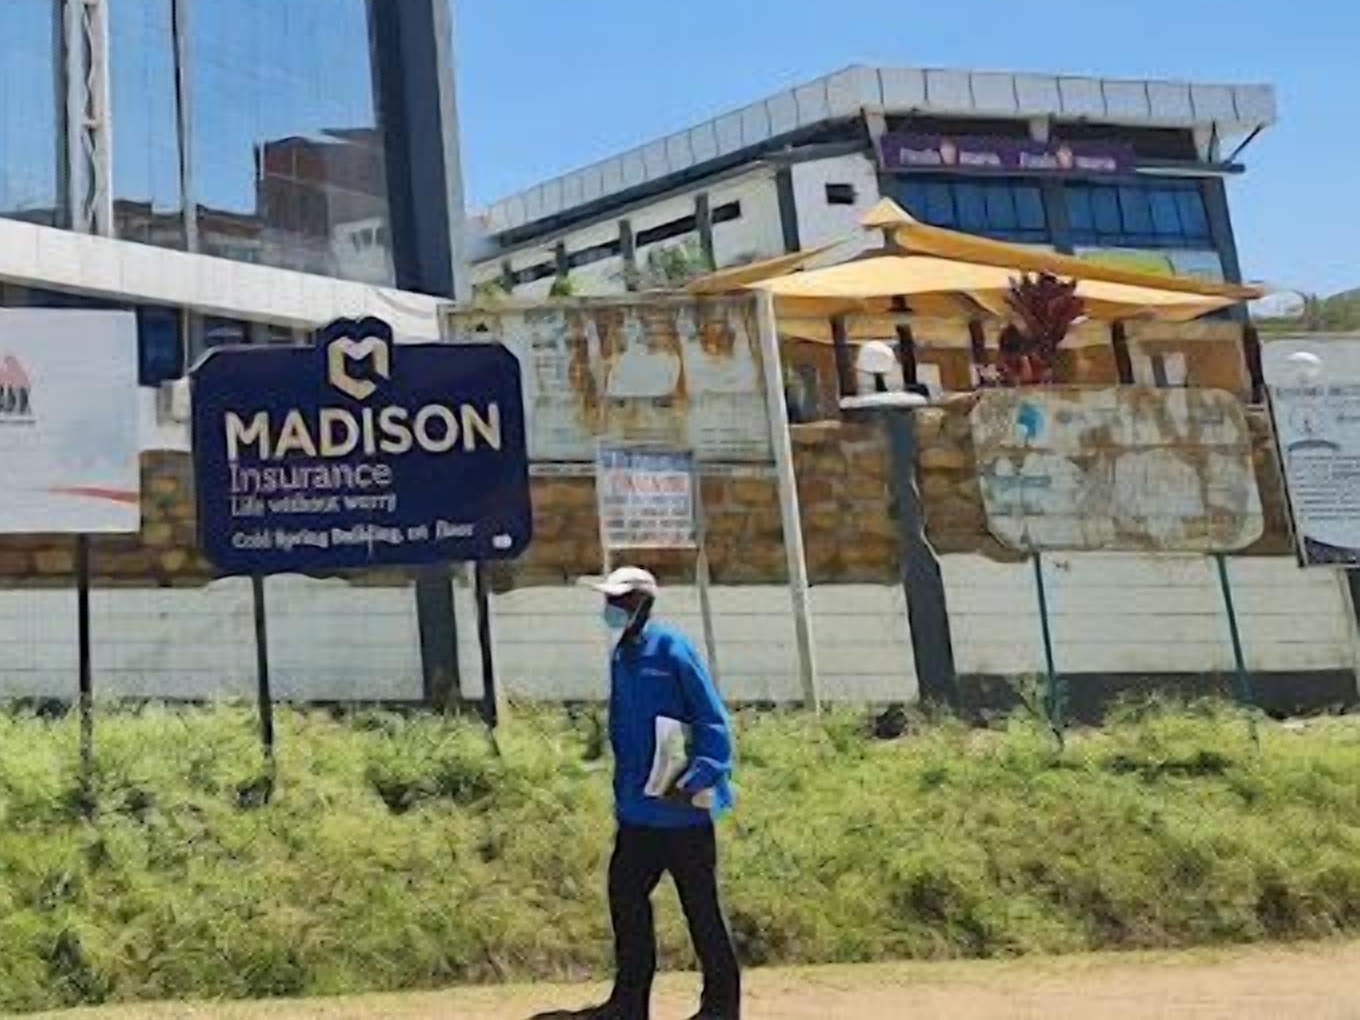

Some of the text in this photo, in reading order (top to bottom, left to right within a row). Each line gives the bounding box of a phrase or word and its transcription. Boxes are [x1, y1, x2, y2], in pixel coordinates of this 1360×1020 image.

[224, 402, 501, 461] MADISON
[229, 462, 392, 493] Insurance
[343, 491, 397, 513] worry
